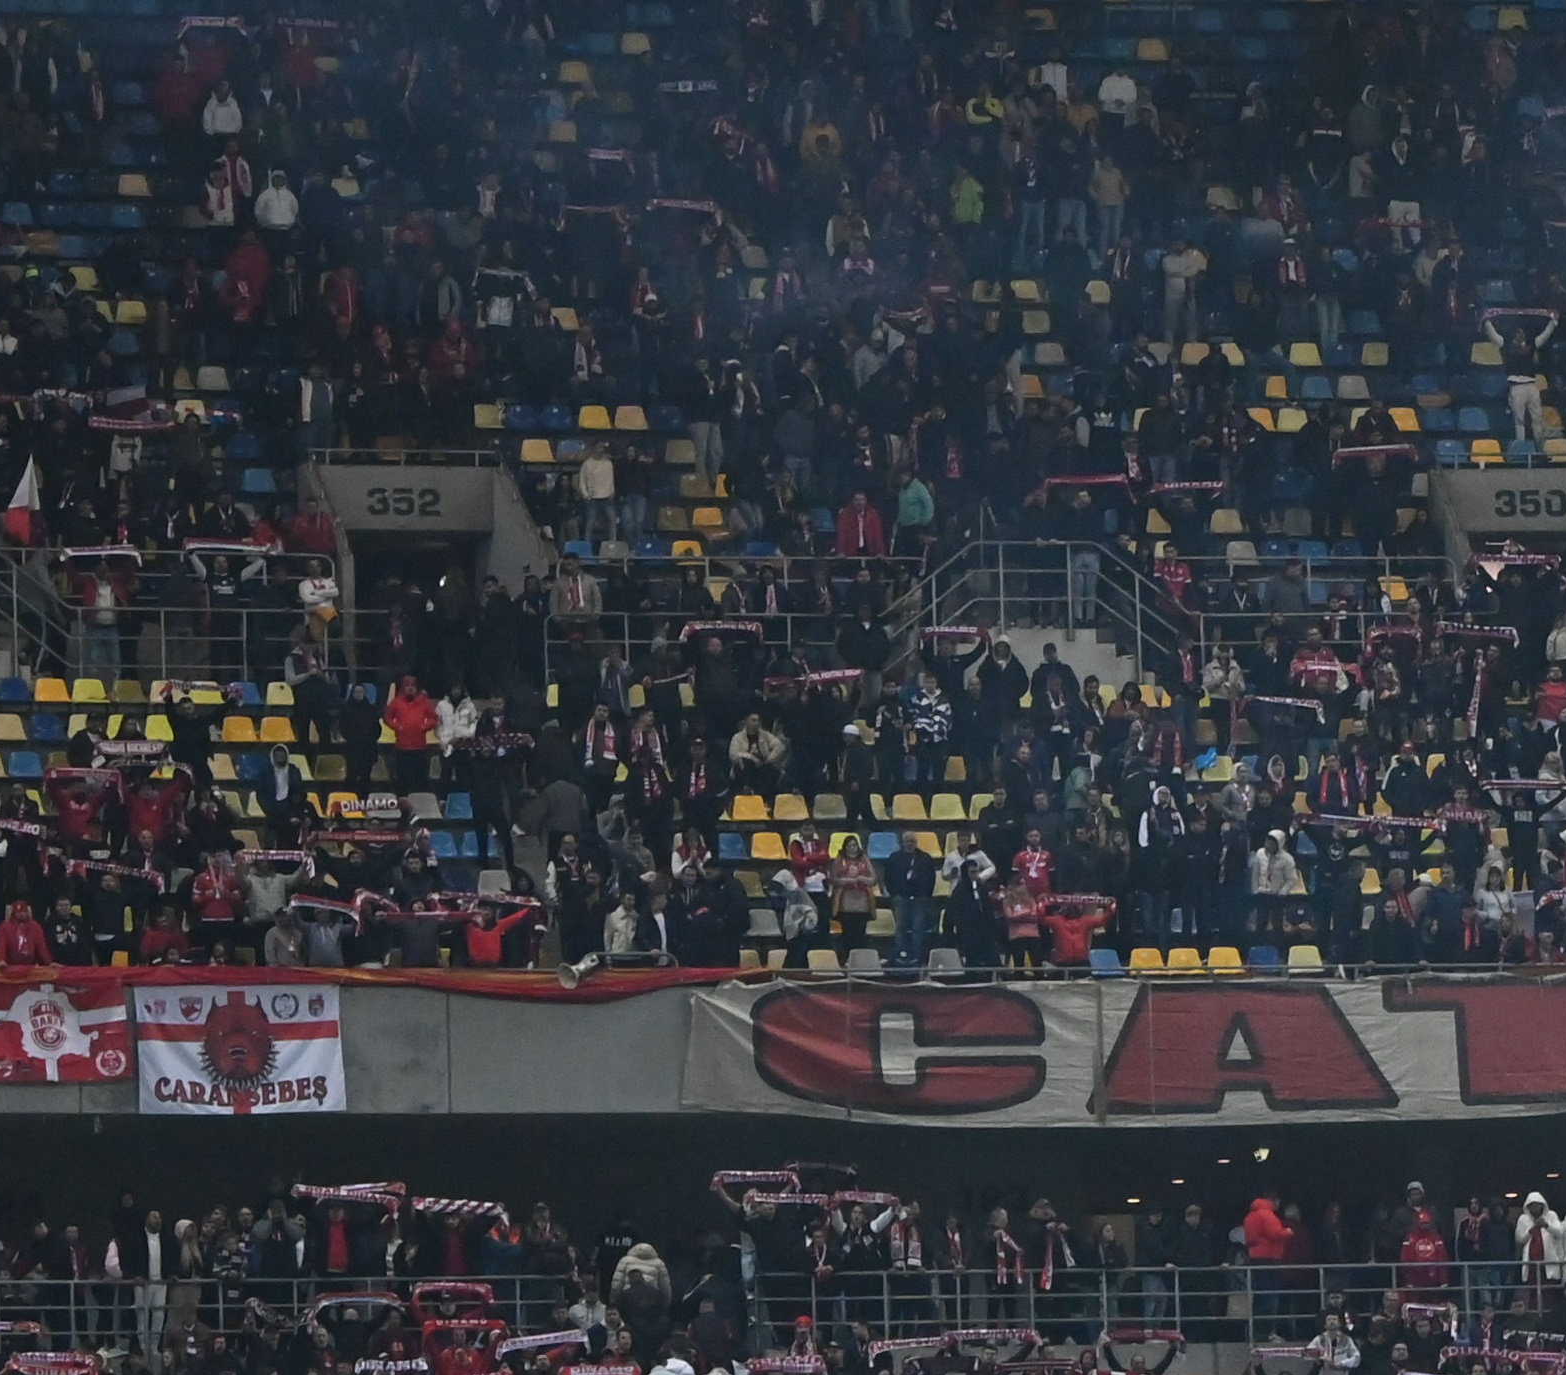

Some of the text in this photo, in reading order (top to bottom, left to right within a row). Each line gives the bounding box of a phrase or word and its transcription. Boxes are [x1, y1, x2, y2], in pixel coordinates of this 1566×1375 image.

[366, 487, 442, 518] 352
[341, 798, 398, 811] DINAMO
[1445, 1345, 1520, 1360] DINAMO
